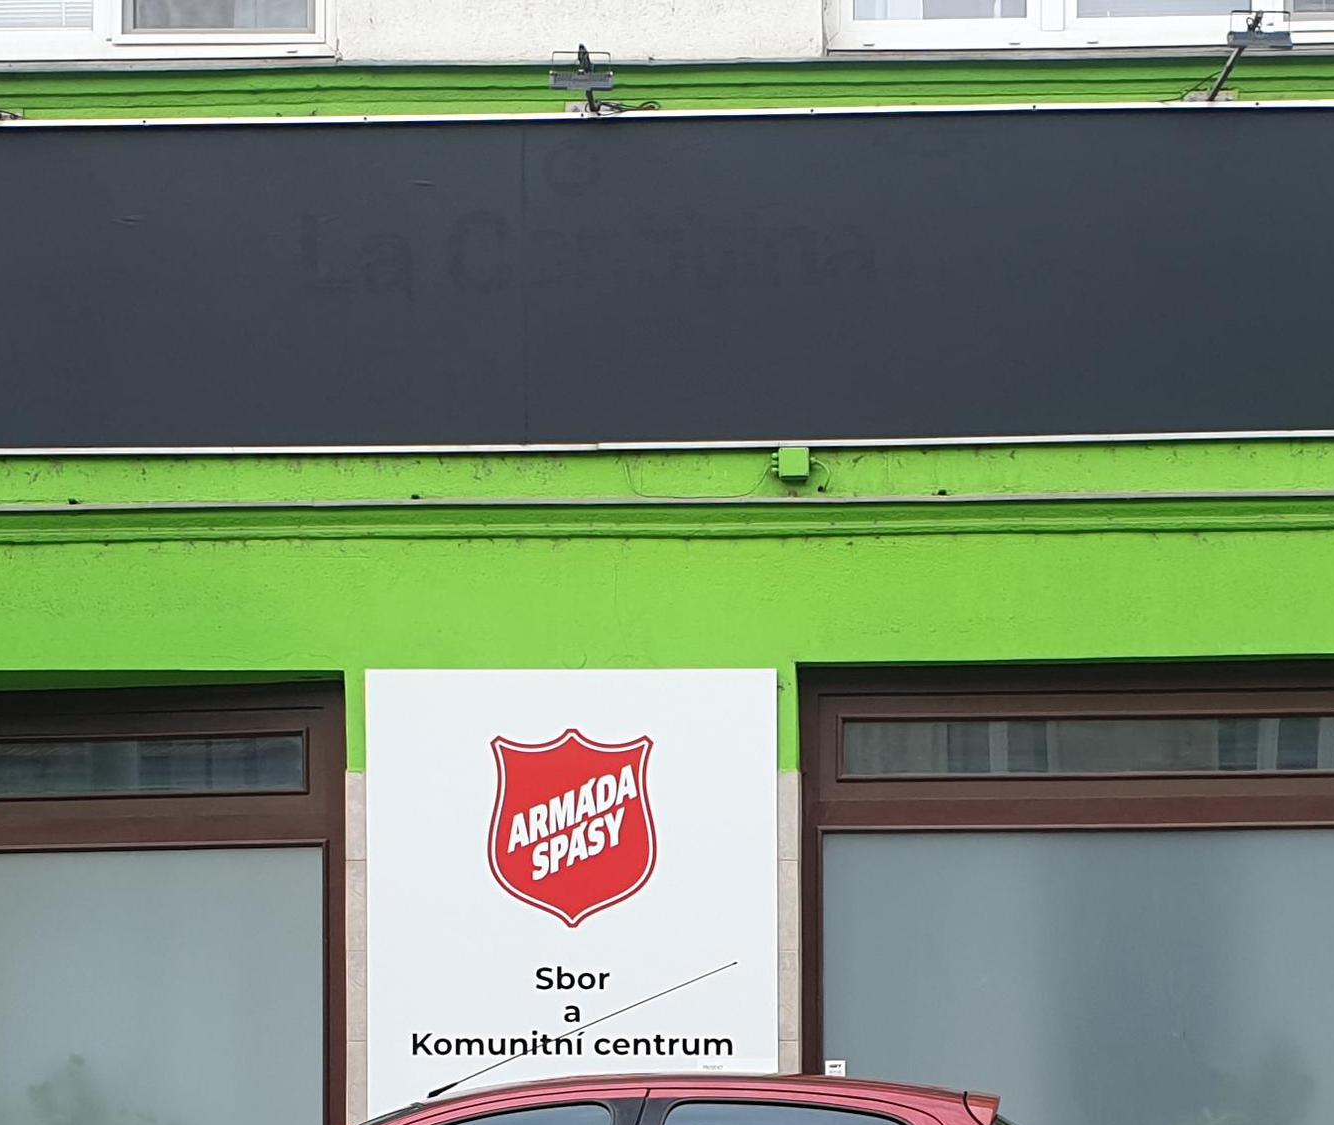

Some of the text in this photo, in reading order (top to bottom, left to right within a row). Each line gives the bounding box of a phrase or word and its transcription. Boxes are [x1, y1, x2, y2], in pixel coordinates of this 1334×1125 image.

[507, 764, 639, 854] ARMÁDA
[531, 807, 625, 881] SPÁSY
[535, 966, 610, 990] Sbor
[563, 1005, 581, 1023] a
[412, 1030, 734, 1056] Komunitní centrum
